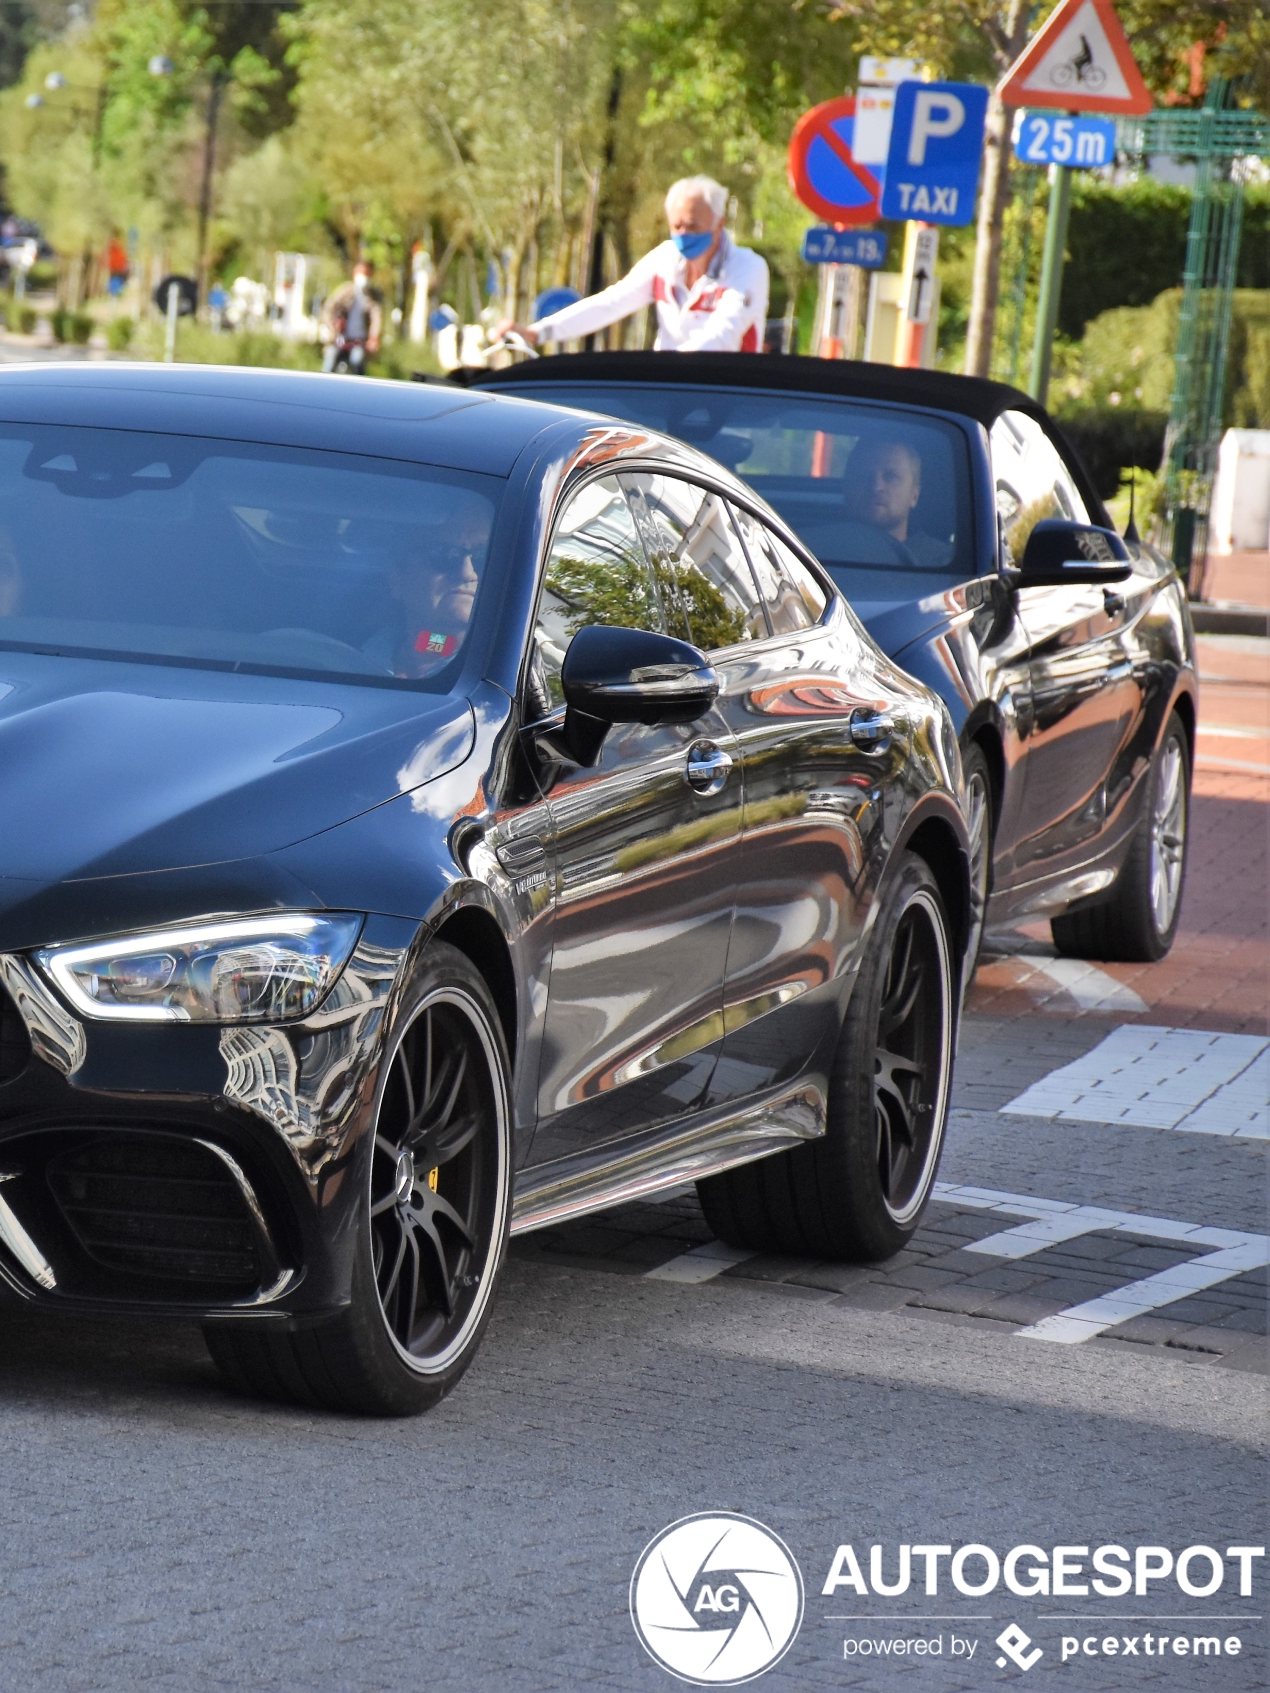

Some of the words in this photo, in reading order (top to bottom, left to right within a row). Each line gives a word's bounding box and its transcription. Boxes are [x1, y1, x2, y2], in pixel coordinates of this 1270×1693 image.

[907, 90, 965, 167] P
[1026, 117, 1106, 163] 25m
[897, 183, 959, 216] TAXI
